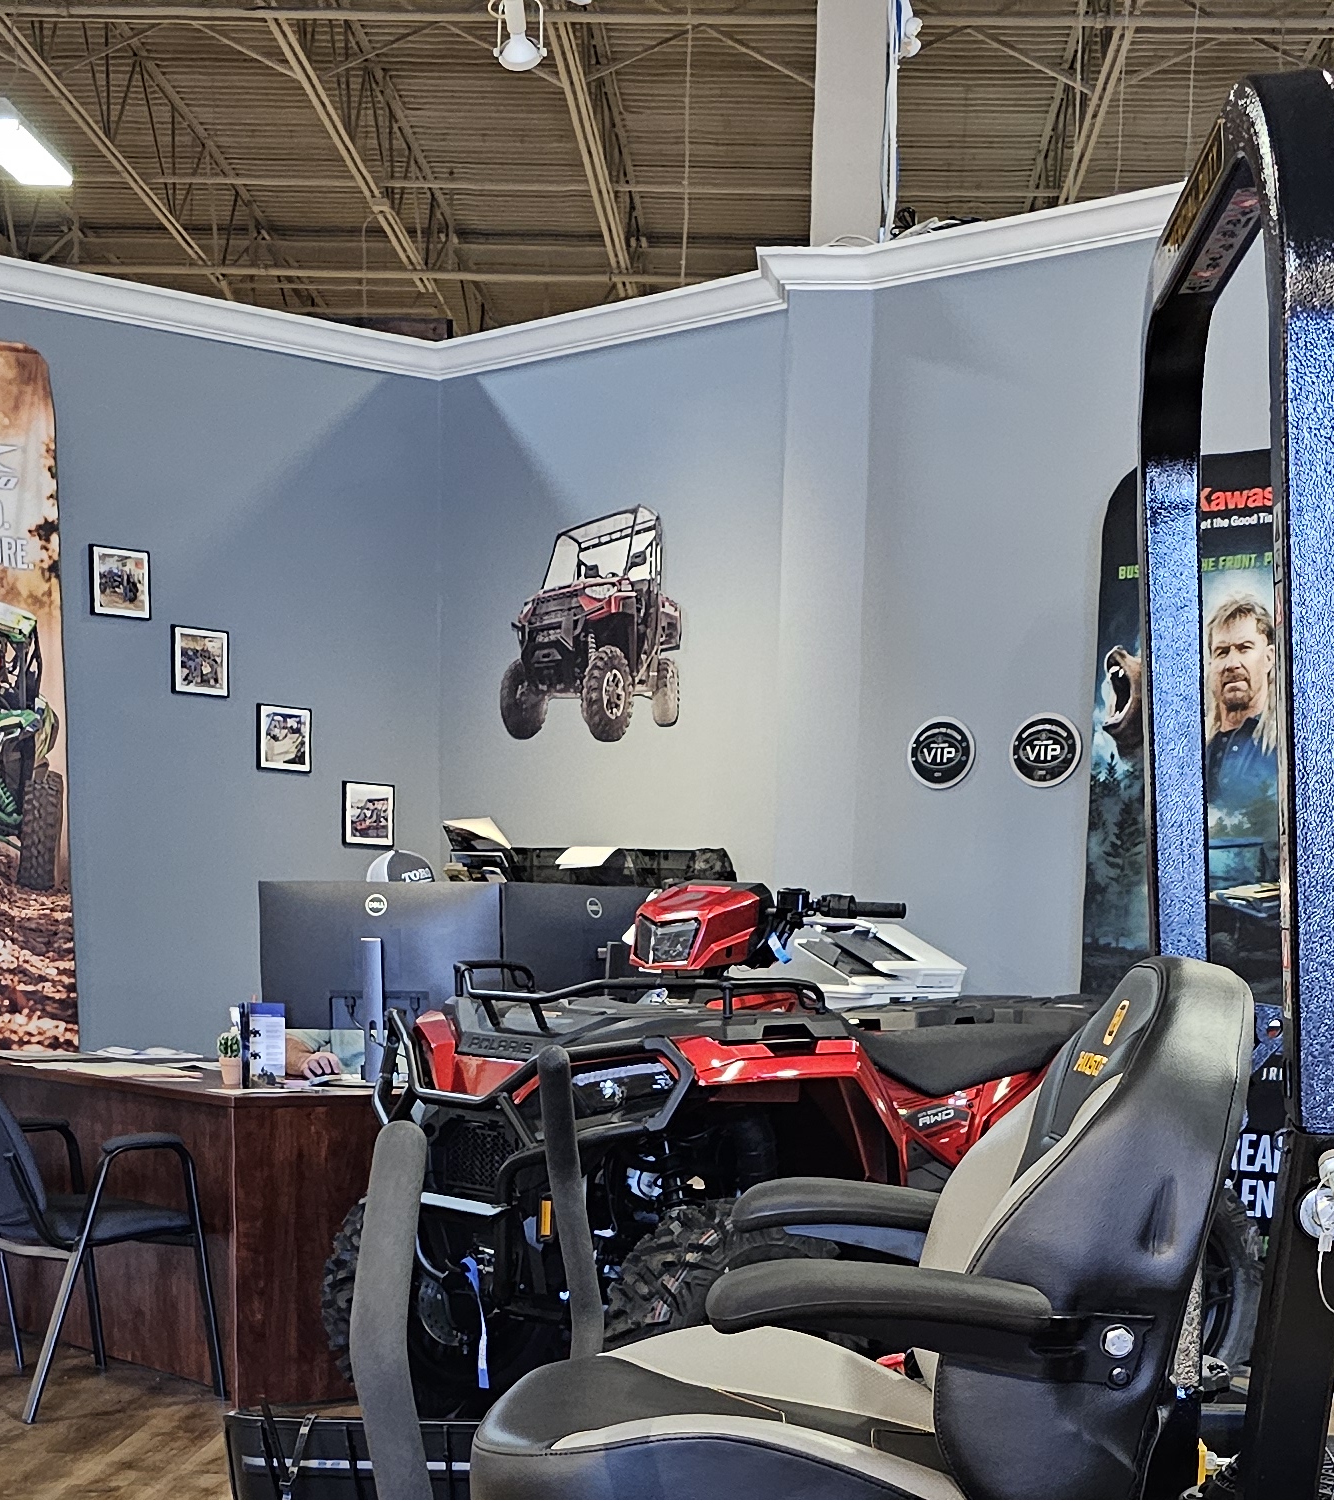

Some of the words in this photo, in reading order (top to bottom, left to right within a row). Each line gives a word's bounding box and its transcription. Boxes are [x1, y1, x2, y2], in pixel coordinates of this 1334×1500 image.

[1200, 486, 1273, 512] Kawas
[1212, 516, 1229, 528] the
[1230, 513, 1257, 527] Good
[922, 747, 956, 763] VIP
[1025, 744, 1061, 761] VIP
[467, 1036, 534, 1054] POLARIS
[918, 1108, 955, 1127] AWD
